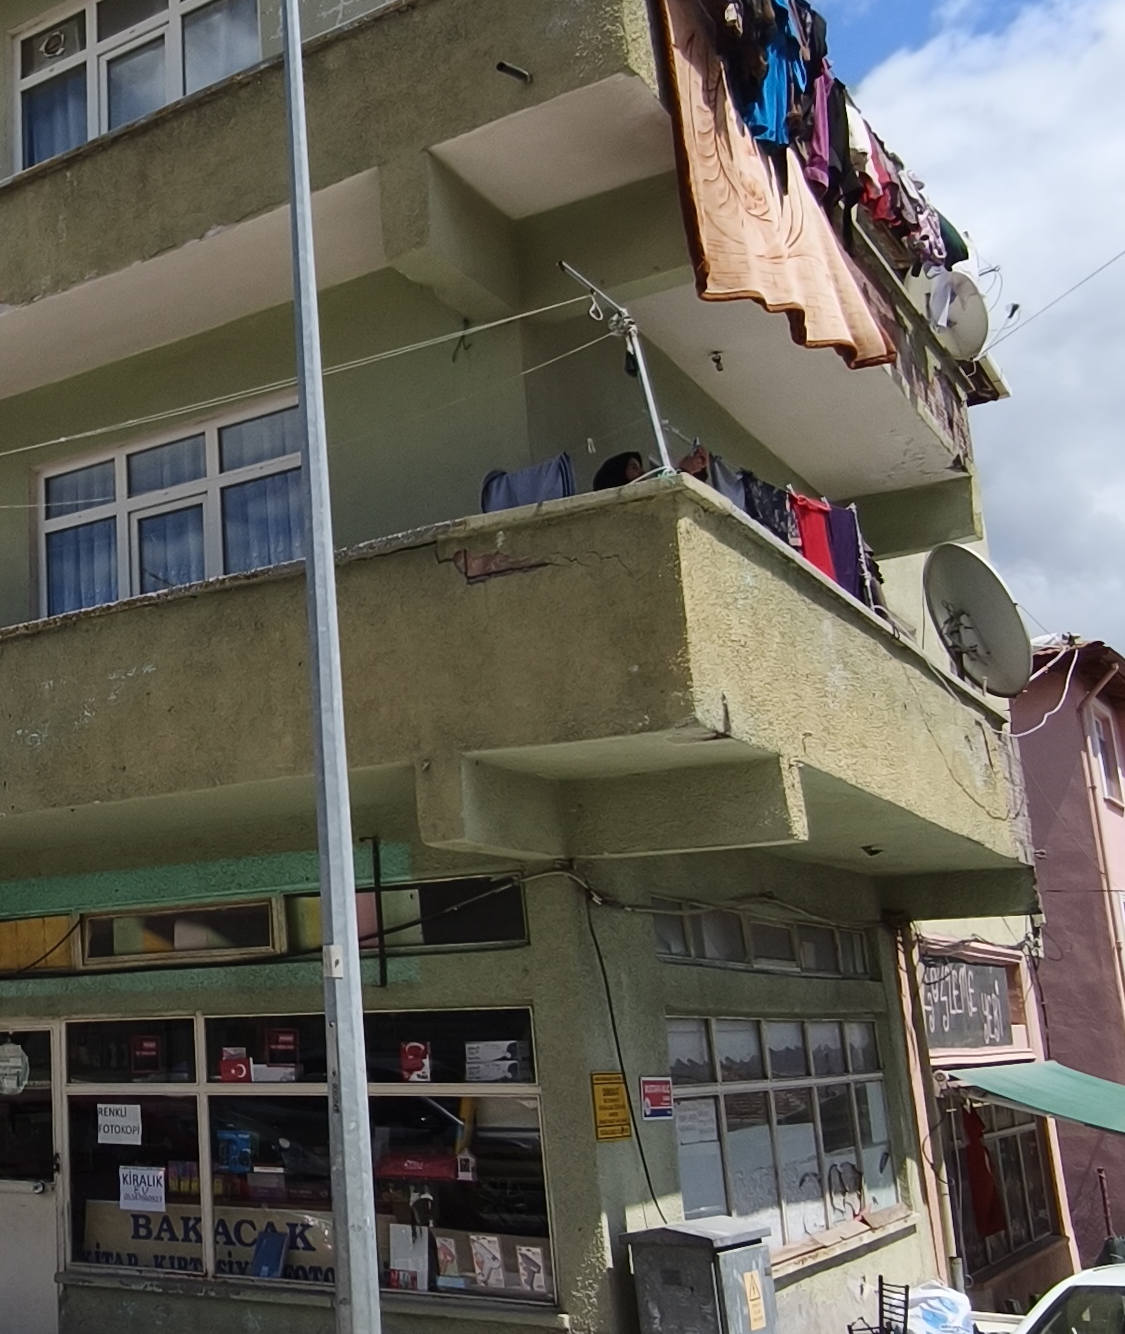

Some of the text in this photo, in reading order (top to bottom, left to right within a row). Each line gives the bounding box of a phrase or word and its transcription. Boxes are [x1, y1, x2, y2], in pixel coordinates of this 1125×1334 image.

[98, 1107, 127, 1117] RENKLİ
[98, 1124, 140, 1135] FOTOKOPİ
[122, 1171, 163, 1187] KİRALIK
